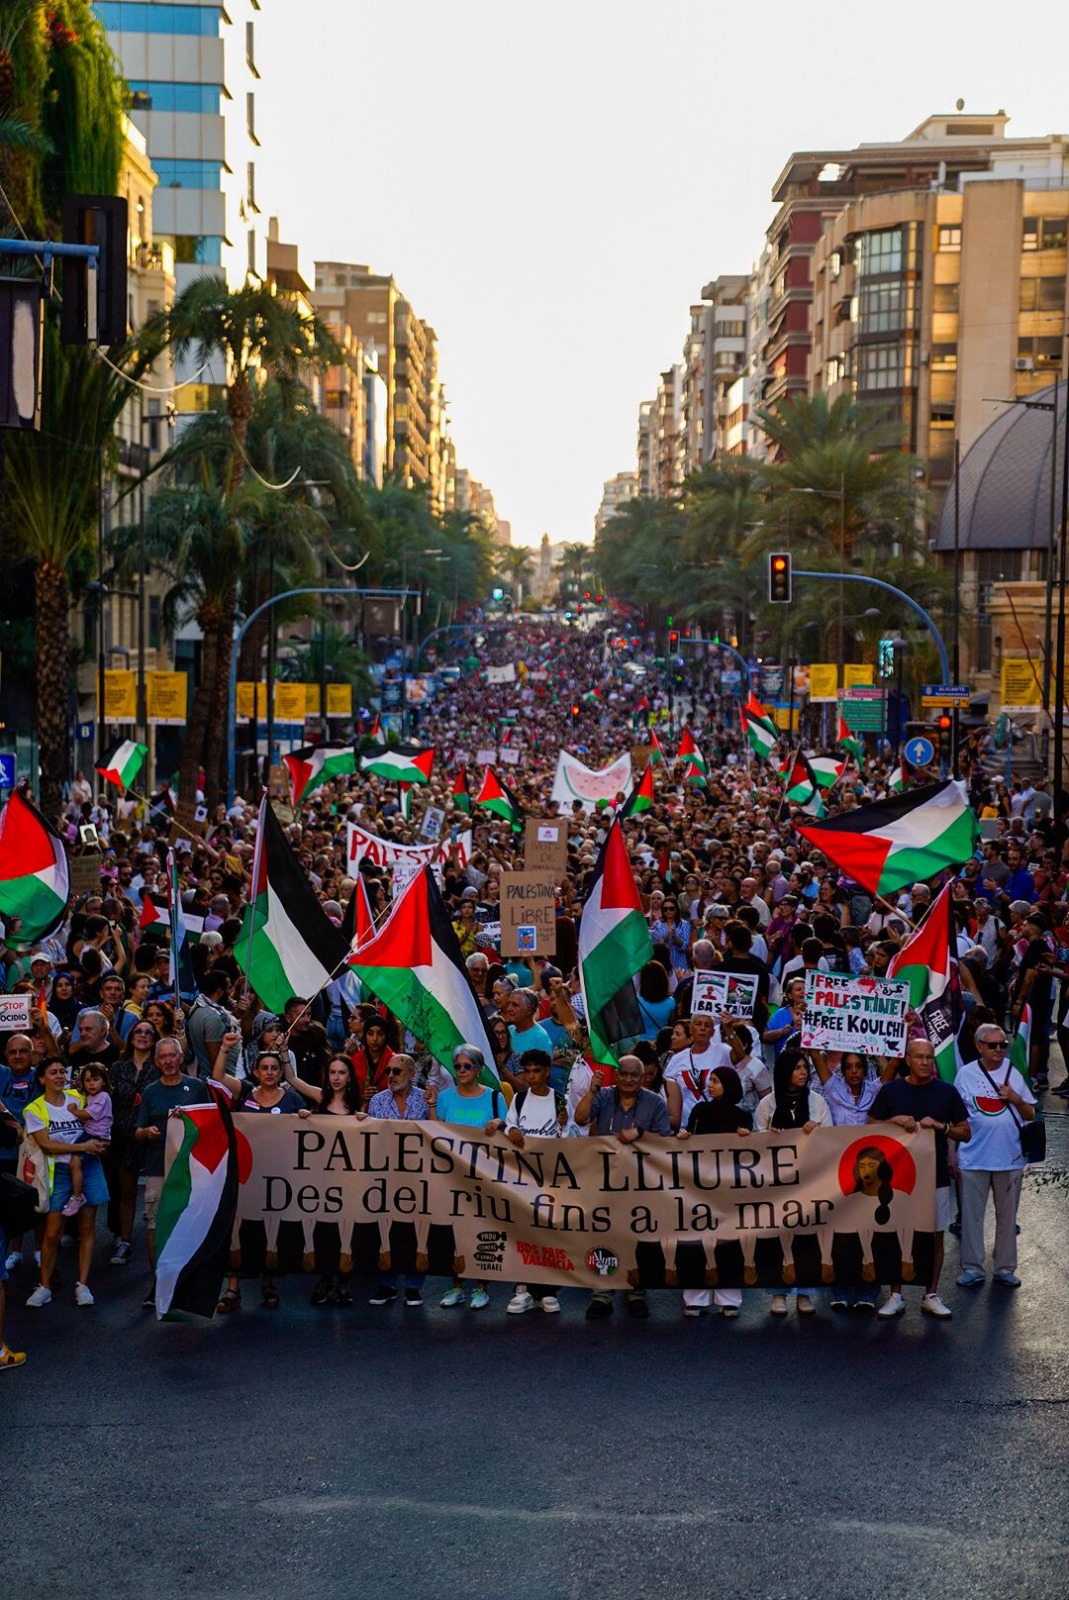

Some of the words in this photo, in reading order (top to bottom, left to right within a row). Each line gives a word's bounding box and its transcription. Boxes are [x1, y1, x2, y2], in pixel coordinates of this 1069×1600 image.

[350, 830, 468, 869] PALESTNA
[506, 883, 556, 900] PALESTINA
[3, 1002, 24, 1010] STOP
[847, 1014, 904, 1038] KOULCHI
[929, 1009, 950, 1033] FREE
[293, 1130, 581, 1190] PALESTINA
[598, 1145, 801, 1192] LLIURE
[262, 1176, 344, 1213] Des
[362, 1178, 432, 1215] del
[449, 1184, 515, 1224] riu
[530, 1193, 612, 1233] fins
[630, 1205, 658, 1234] a
[674, 1196, 719, 1232] la
[735, 1199, 834, 1230] mar
[480, 1263, 503, 1271] ISRAEL
